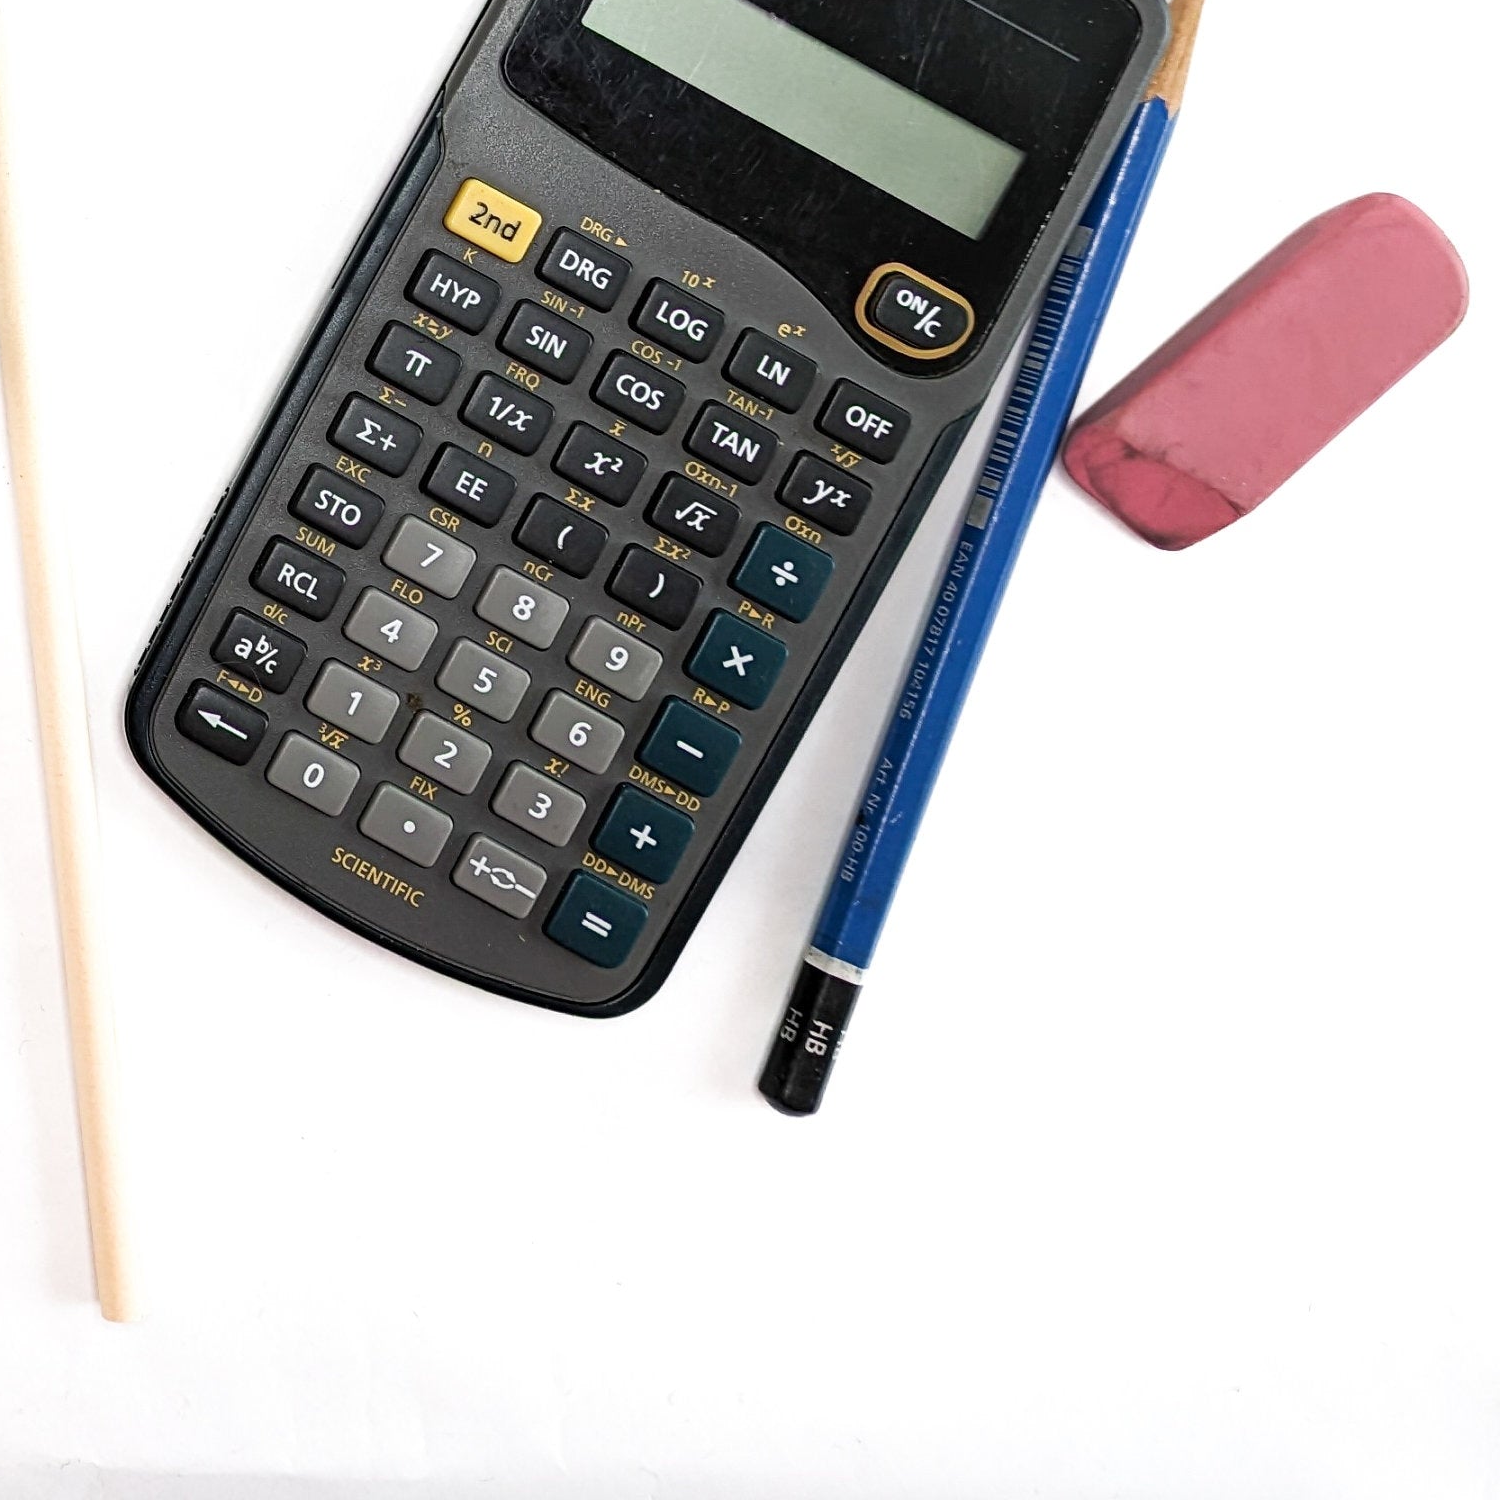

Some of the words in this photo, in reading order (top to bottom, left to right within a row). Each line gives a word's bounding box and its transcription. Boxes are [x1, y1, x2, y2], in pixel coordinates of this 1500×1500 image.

[467, 201, 523, 243] 2nd
[580, 215, 614, 244] DRG
[463, 247, 478, 265] K
[558, 248, 613, 291] DRG
[429, 273, 481, 310] HYP
[655, 300, 709, 343] LOG
[525, 325, 567, 360] SIN
[504, 361, 541, 392] FRQ
[755, 353, 791, 387] LN
[615, 373, 666, 411] COS
[484, 395, 533, 433] 1/x
[844, 404, 894, 440] OFF
[710, 421, 761, 463] TAN
[335, 454, 373, 485] EXC
[454, 469, 490, 502] EE
[313, 488, 363, 527] STO
[428, 505, 462, 534] CSR
[295, 525, 337, 558] SUM
[420, 541, 445, 568] 7
[277, 562, 319, 601] RCL
[522, 559, 555, 583] nCr
[390, 577, 424, 605] FLO
[263, 602, 289, 626] d/c
[511, 593, 537, 621] 8
[616, 610, 647, 634] nPr
[380, 618, 404, 645] 4
[484, 629, 514, 654] SCI
[604, 645, 630, 672] 9
[472, 666, 498, 693] 5
[573, 678, 612, 710] ENG
[898, 661, 931, 721] 104156
[347, 691, 363, 717] 1
[567, 721, 593, 747] 6
[433, 739, 459, 769] 2
[301, 762, 326, 789] 0
[408, 774, 439, 801] FIX
[527, 791, 553, 820] 3
[330, 846, 426, 909] SCIENTIFIC
[779, 1006, 804, 1044] HB
[803, 1019, 835, 1056] HB
